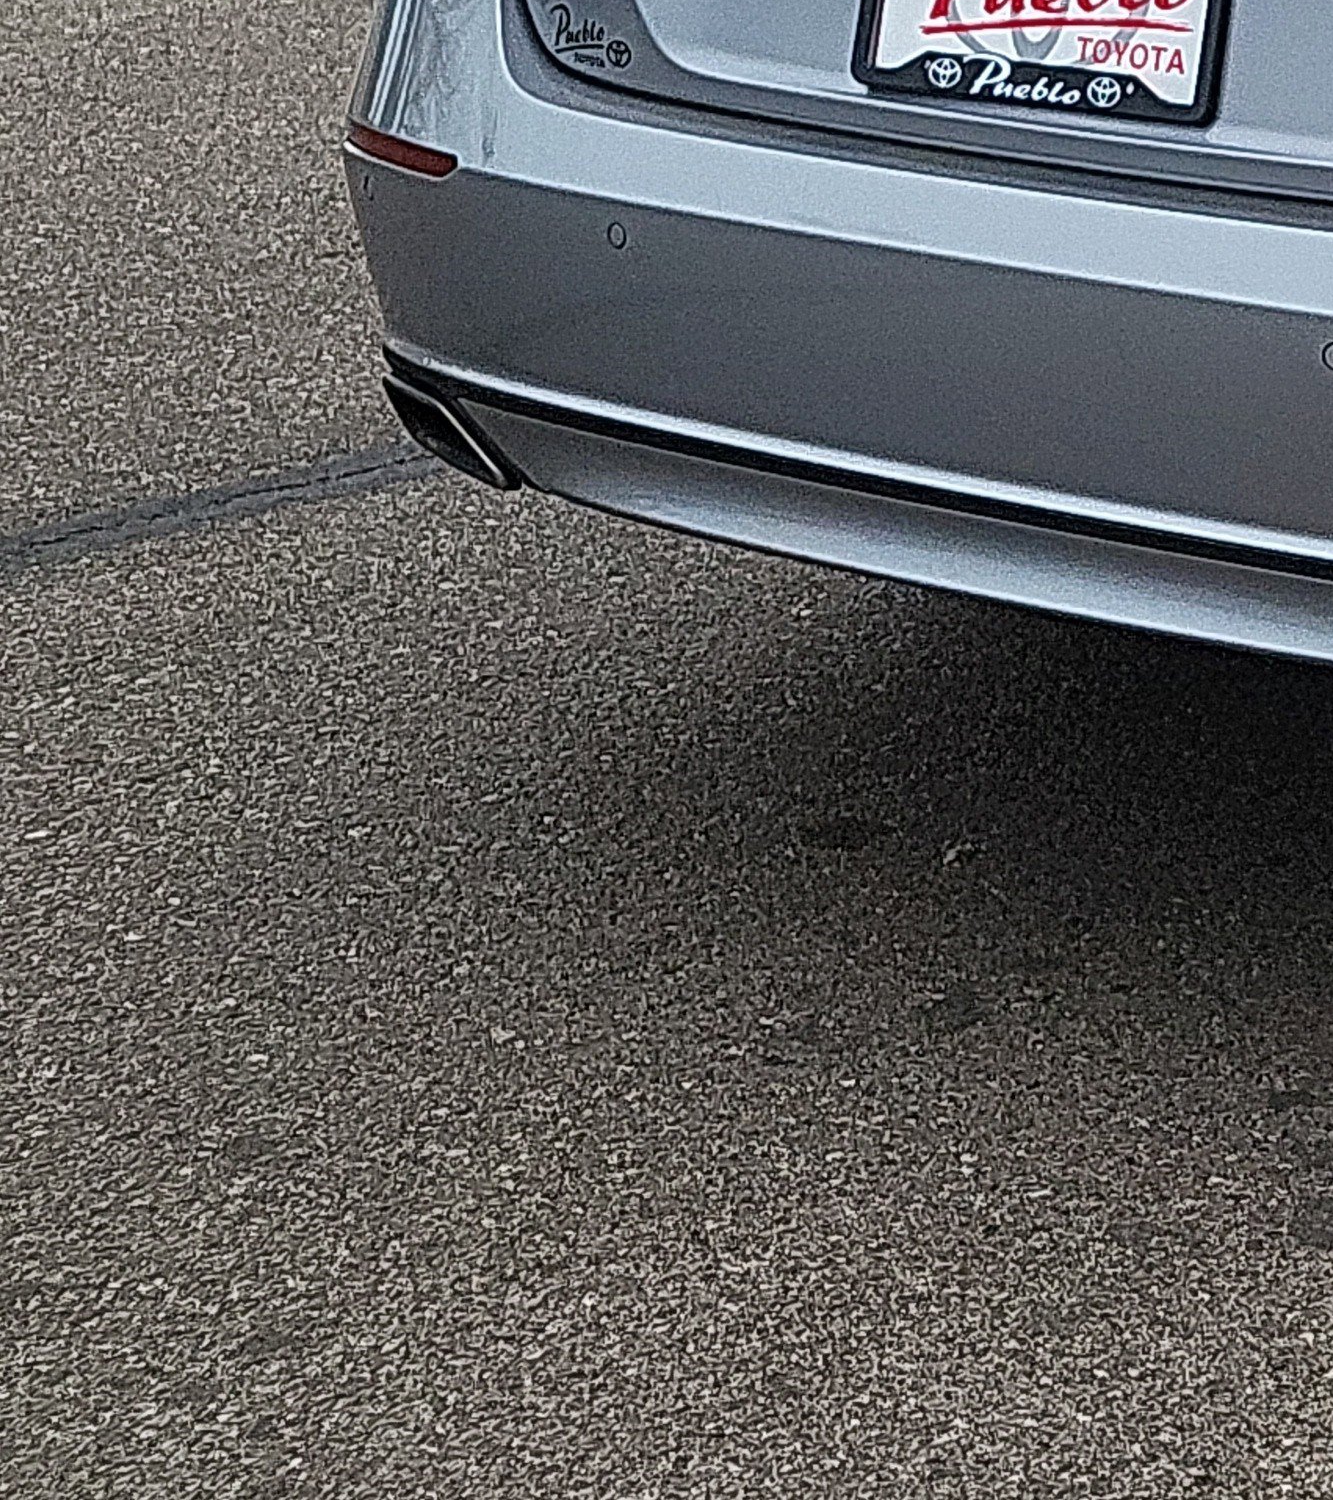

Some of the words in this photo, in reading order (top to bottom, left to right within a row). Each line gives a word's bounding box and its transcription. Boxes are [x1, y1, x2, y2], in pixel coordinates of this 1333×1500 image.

[549, 2, 605, 46] Pueblo
[1076, 36, 1185, 75] TOYOTA
[962, 53, 1082, 105] Pueblo
